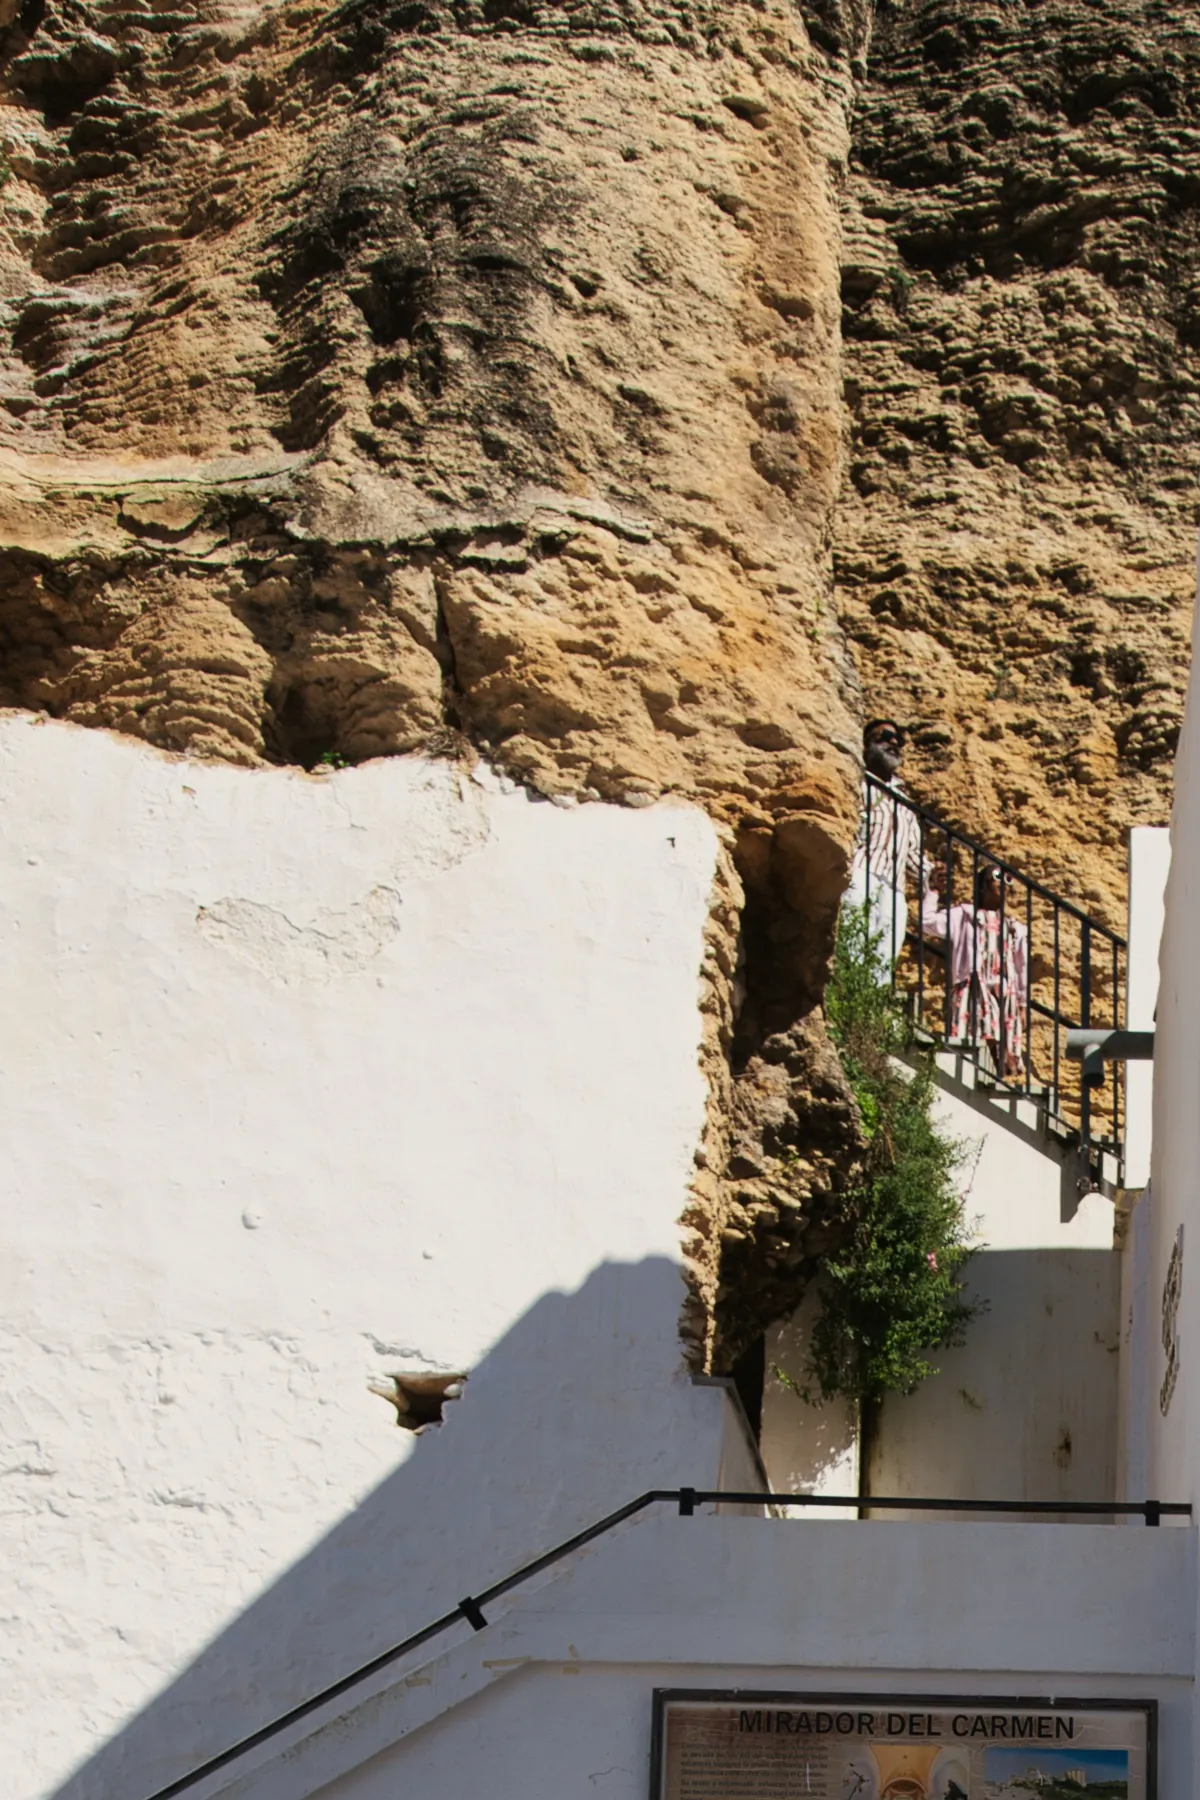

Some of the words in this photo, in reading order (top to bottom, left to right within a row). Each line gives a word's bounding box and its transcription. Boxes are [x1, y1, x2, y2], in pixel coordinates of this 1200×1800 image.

[739, 1710, 874, 1735] MIRADOR
[887, 1713, 942, 1736] DEL
[951, 1714, 1074, 1738] CARMEN
